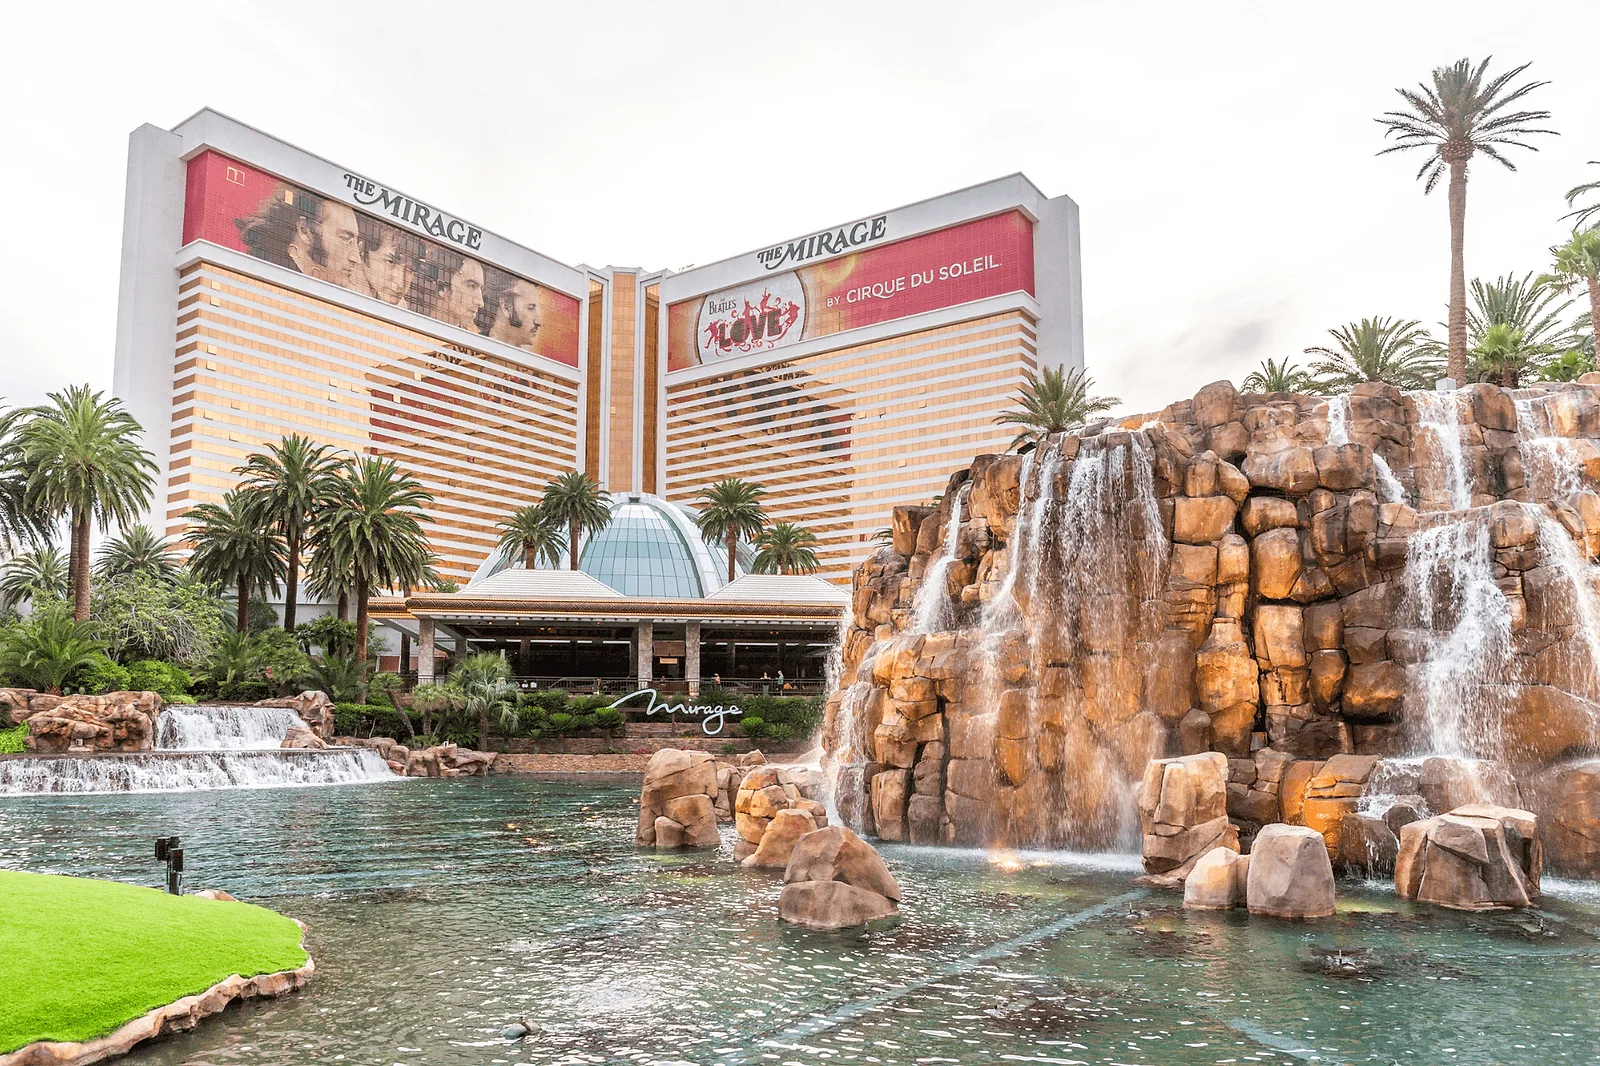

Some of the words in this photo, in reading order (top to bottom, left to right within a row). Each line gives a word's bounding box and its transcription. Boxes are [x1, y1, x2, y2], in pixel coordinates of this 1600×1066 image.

[344, 173, 375, 197] THE
[354, 188, 482, 250] MIRAGE
[757, 246, 783, 264] THE
[765, 215, 887, 270] MIRAGE
[827, 296, 840, 307] BY
[846, 277, 905, 303] CIRQUE
[910, 270, 934, 289] DU
[939, 254, 1000, 280] SOLEIL
[709, 300, 737, 315] BEATLES
[717, 308, 783, 349] LOVE
[605, 688, 743, 735] Mirage
